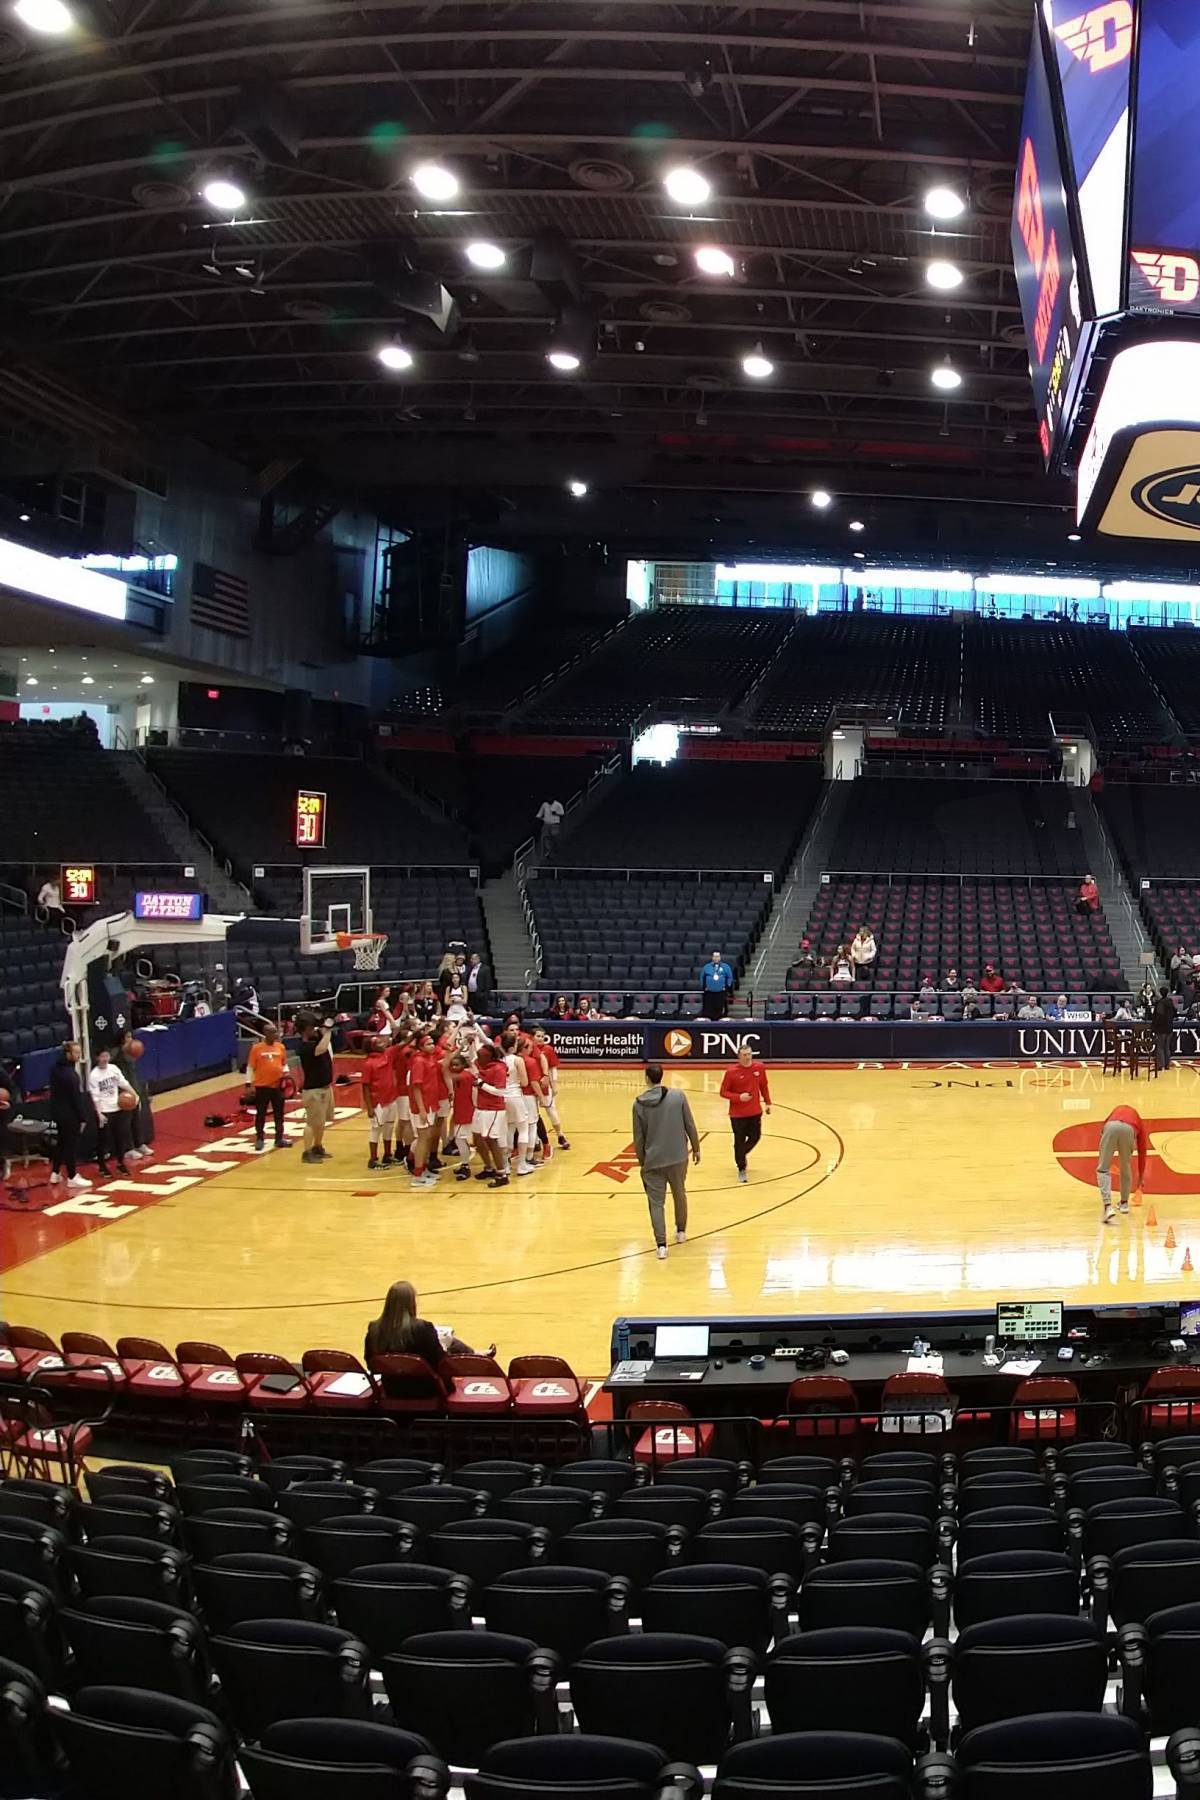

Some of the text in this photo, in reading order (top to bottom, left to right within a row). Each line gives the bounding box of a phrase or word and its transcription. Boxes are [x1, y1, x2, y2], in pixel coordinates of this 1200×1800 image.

[70, 882, 88, 898] 30
[141, 894, 193, 906] DAYTON
[143, 905, 190, 917] FLYERS
[553, 1033, 644, 1046] Premier Health
[701, 1033, 761, 1056] PNC
[554, 1046, 639, 1057] Miami Valley Hospital
